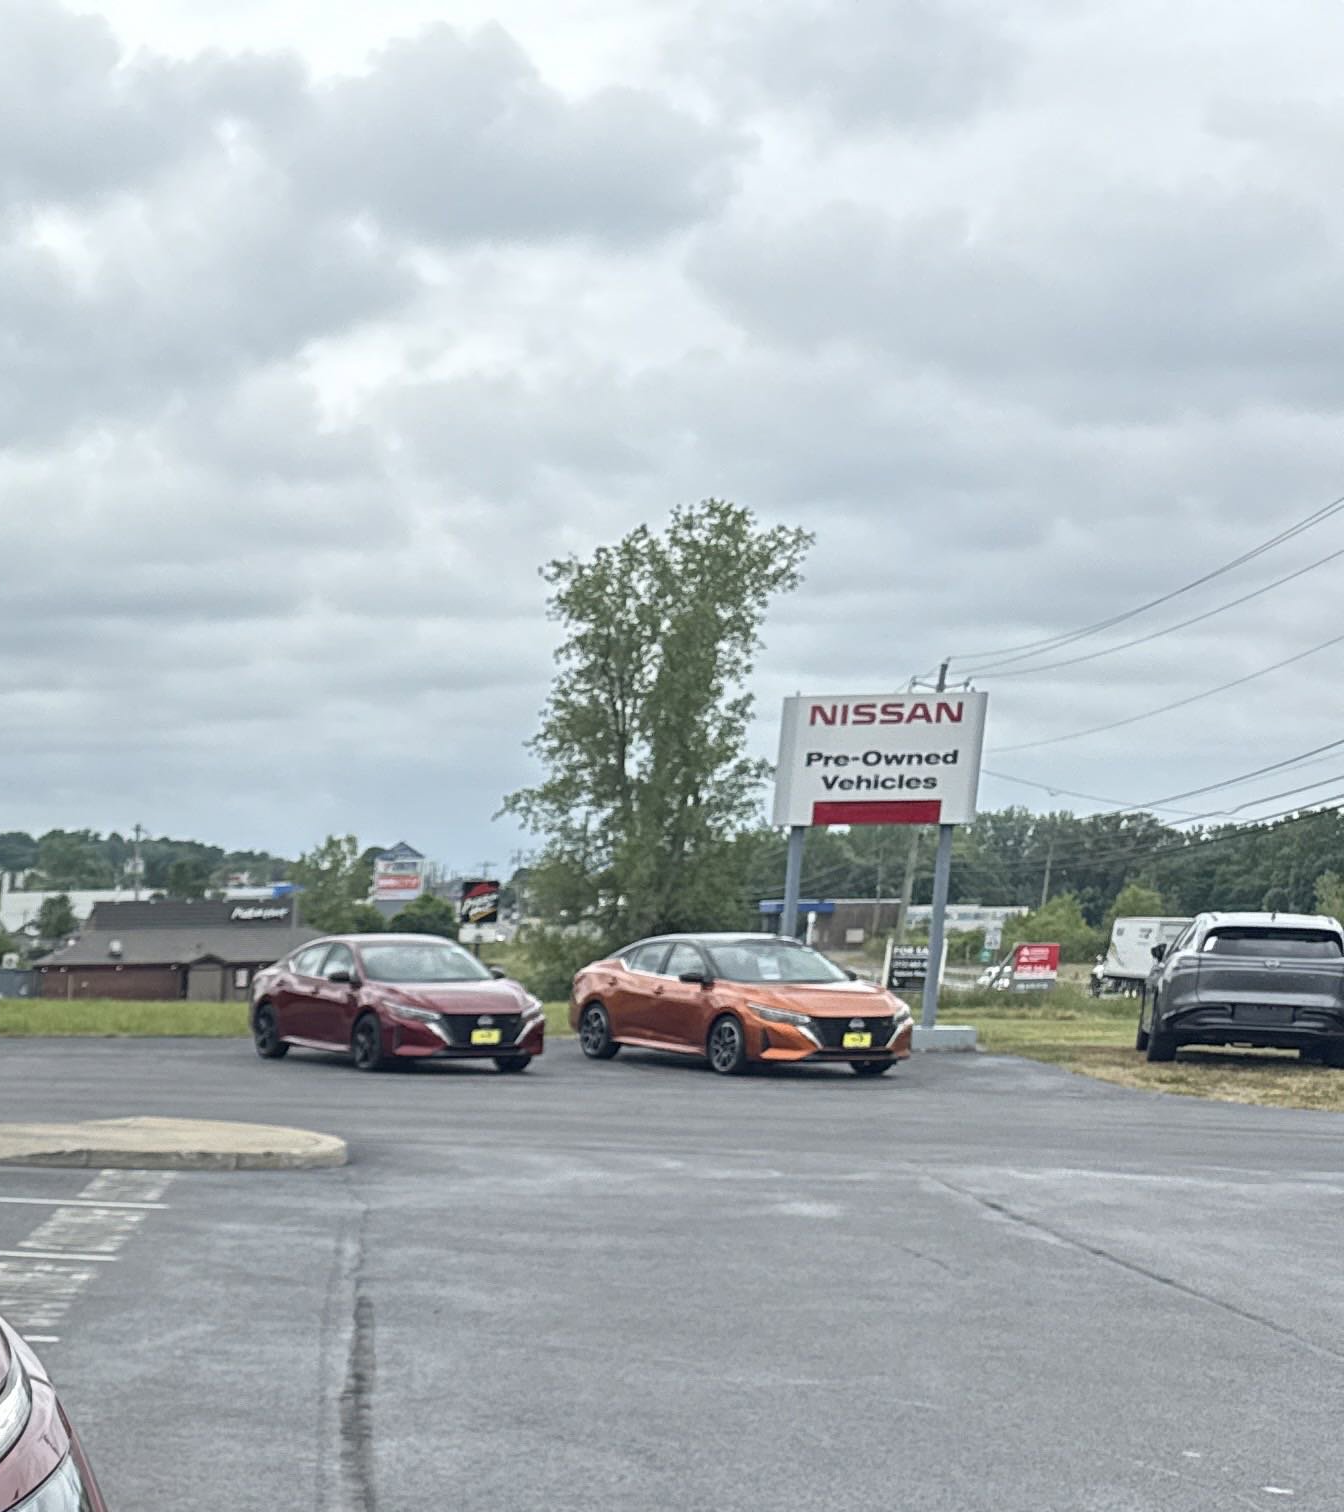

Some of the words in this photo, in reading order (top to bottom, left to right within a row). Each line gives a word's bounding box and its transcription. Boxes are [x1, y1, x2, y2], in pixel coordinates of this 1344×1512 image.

[809, 701, 964, 726] NISSAN
[805, 749, 959, 767] Pre-Owned
[822, 774, 938, 791] Vehicles
